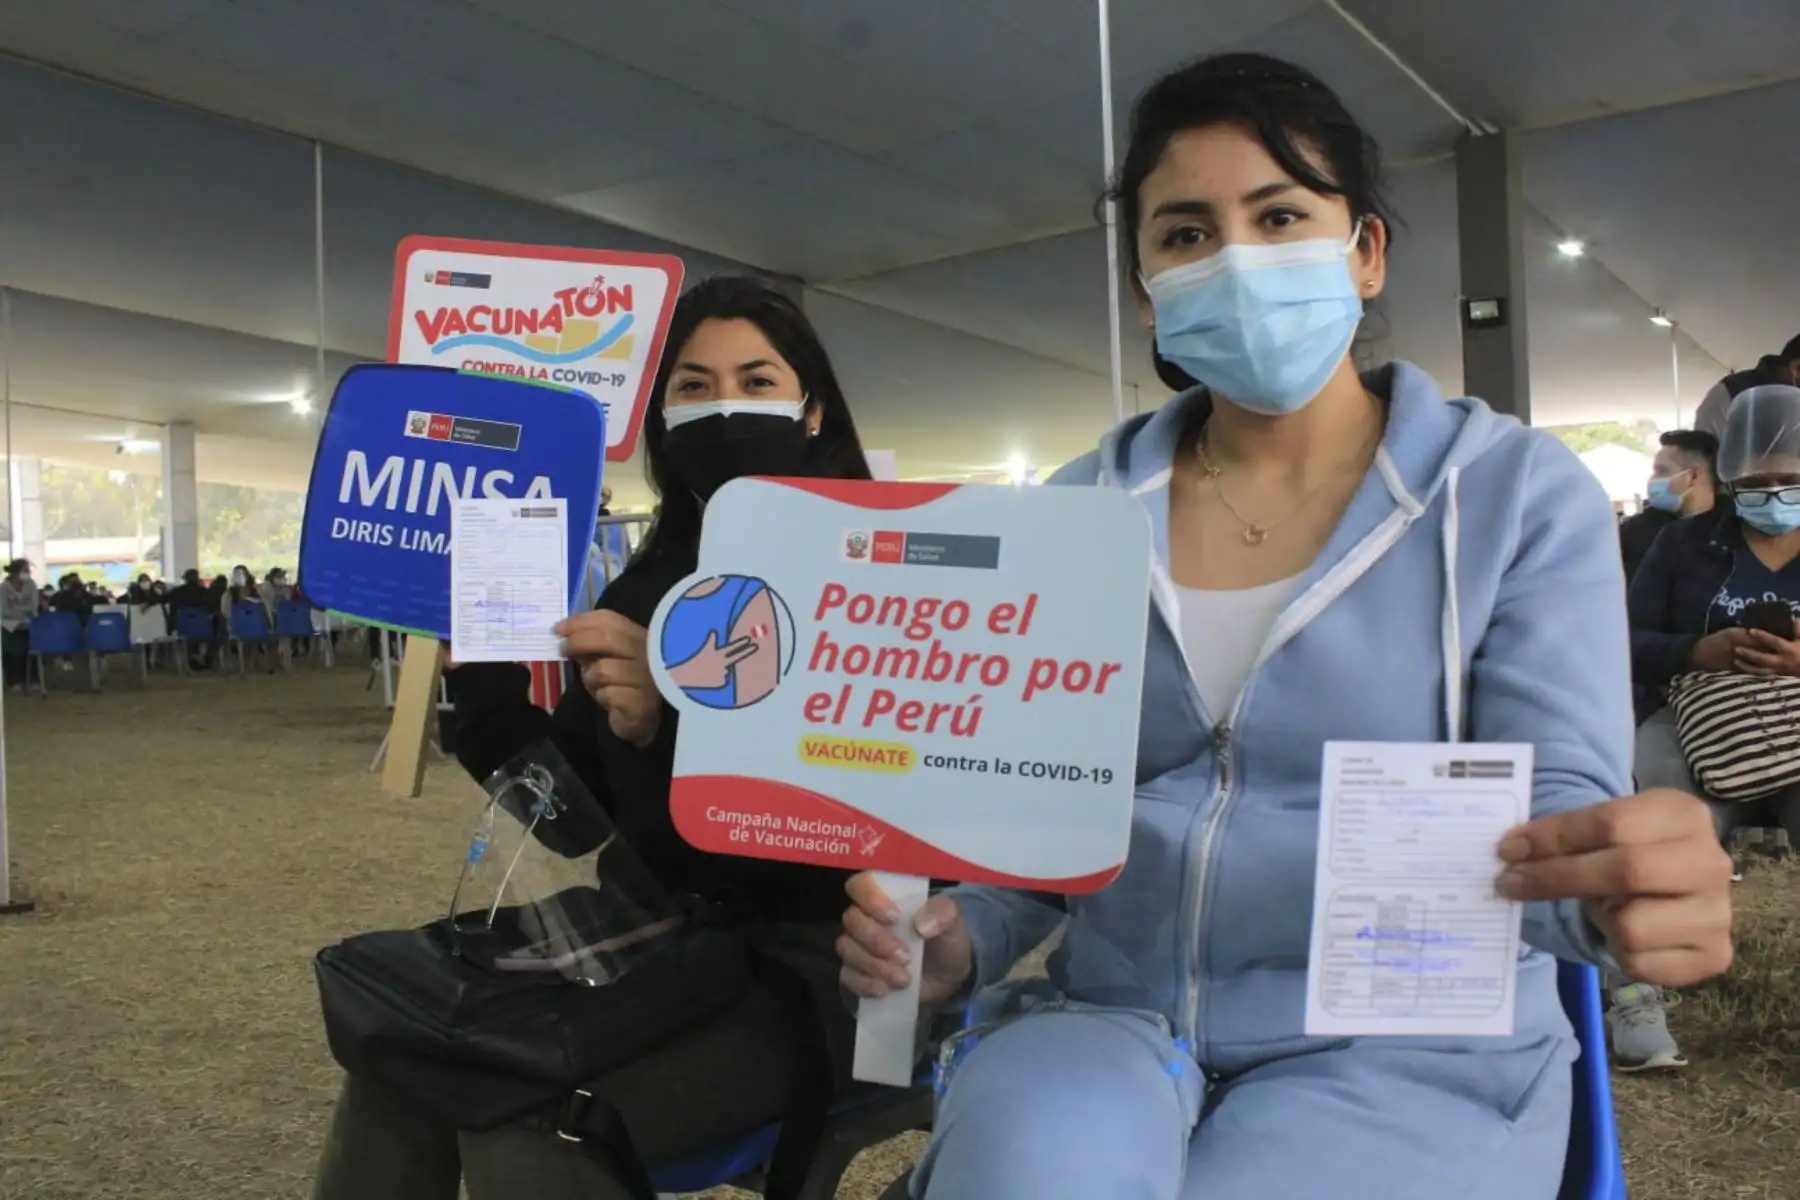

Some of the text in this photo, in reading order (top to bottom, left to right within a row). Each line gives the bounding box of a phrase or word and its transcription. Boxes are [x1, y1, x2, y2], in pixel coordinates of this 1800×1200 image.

[462, 360, 626, 387] CONTRA LA COVID-19
[331, 517, 393, 546] DIRIS
[814, 582, 1038, 641] Pongo el
[808, 631, 1122, 702] hombro por
[803, 683, 984, 738] el Perú
[804, 740, 1113, 784] VACÚNATE contra la COVID-19
[706, 806, 857, 838] Campaña Nacional
[729, 826, 850, 854] de Vacunación
